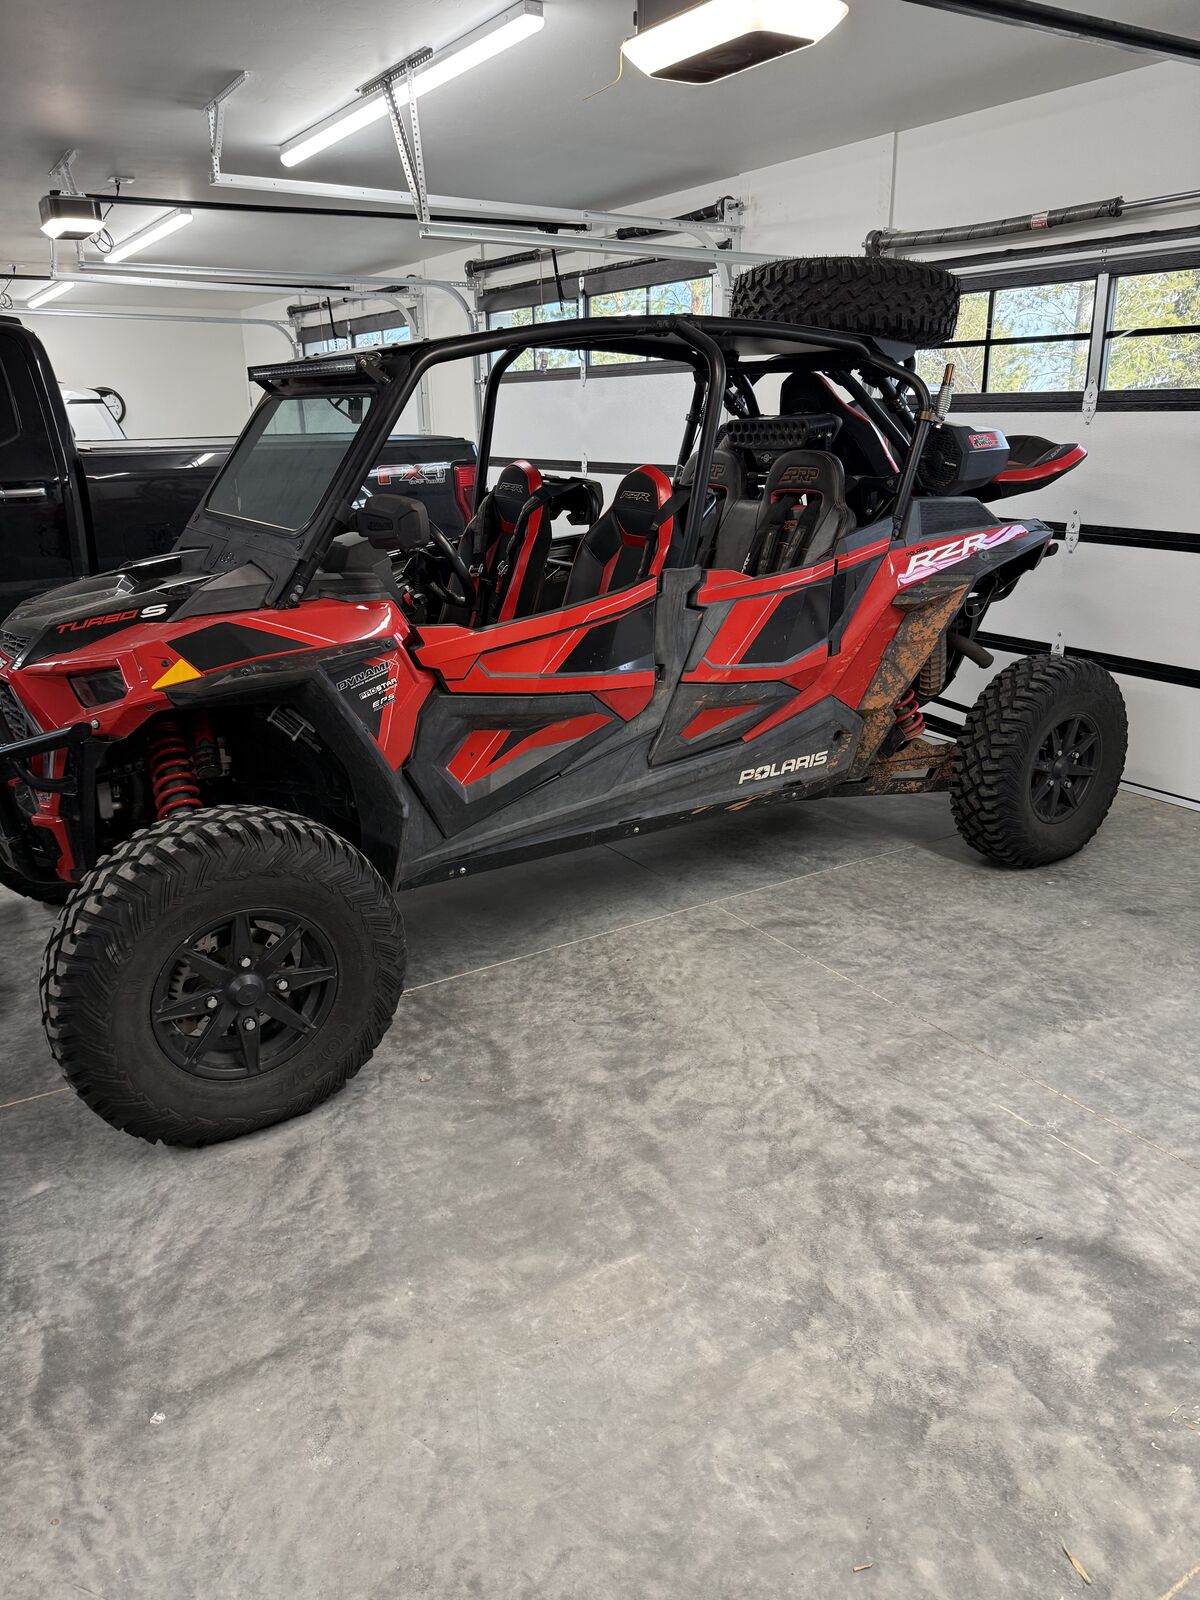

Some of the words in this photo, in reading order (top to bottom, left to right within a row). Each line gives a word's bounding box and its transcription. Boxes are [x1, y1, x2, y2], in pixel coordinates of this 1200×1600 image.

[377, 463, 446, 485] FX4
[905, 533, 988, 577] RZR
[56, 608, 140, 634] TURBO
[140, 603, 168, 618] S
[372, 692, 395, 708] EPS
[738, 750, 829, 785] POLARIS
